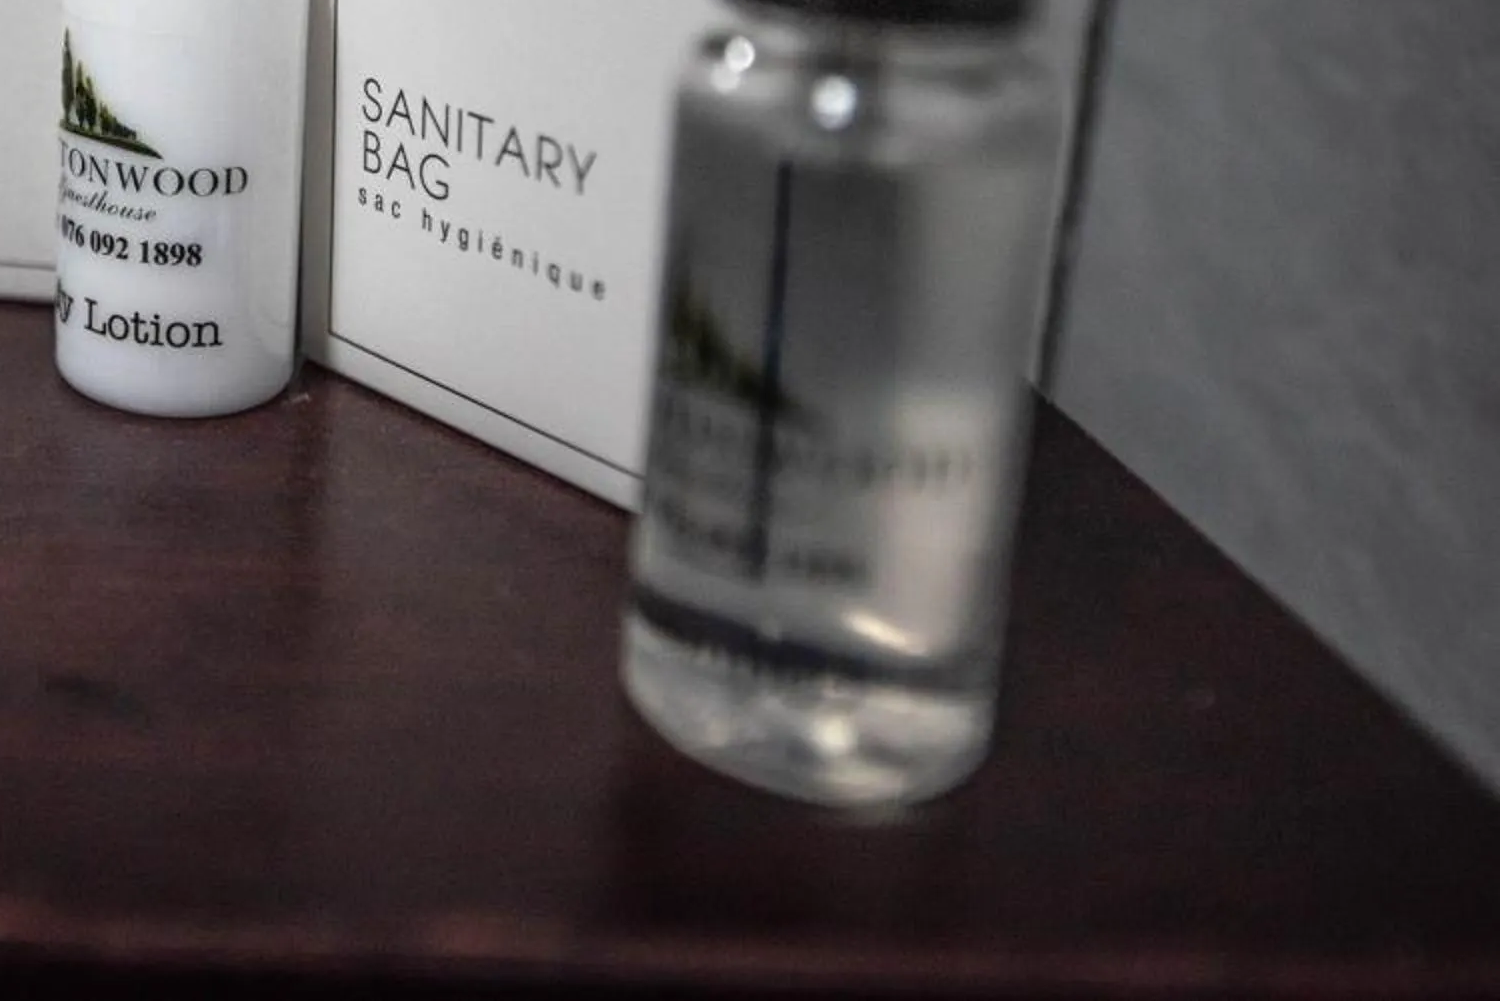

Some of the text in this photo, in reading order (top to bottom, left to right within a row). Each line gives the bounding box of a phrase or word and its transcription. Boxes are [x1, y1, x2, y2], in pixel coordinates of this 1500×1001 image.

[362, 77, 598, 196] SANITARY
[363, 129, 450, 201] BAG
[89, 230, 130, 261] 092
[139, 241, 203, 267] 1898
[357, 186, 606, 301] sac hygiénique
[84, 297, 223, 349] Lotion
